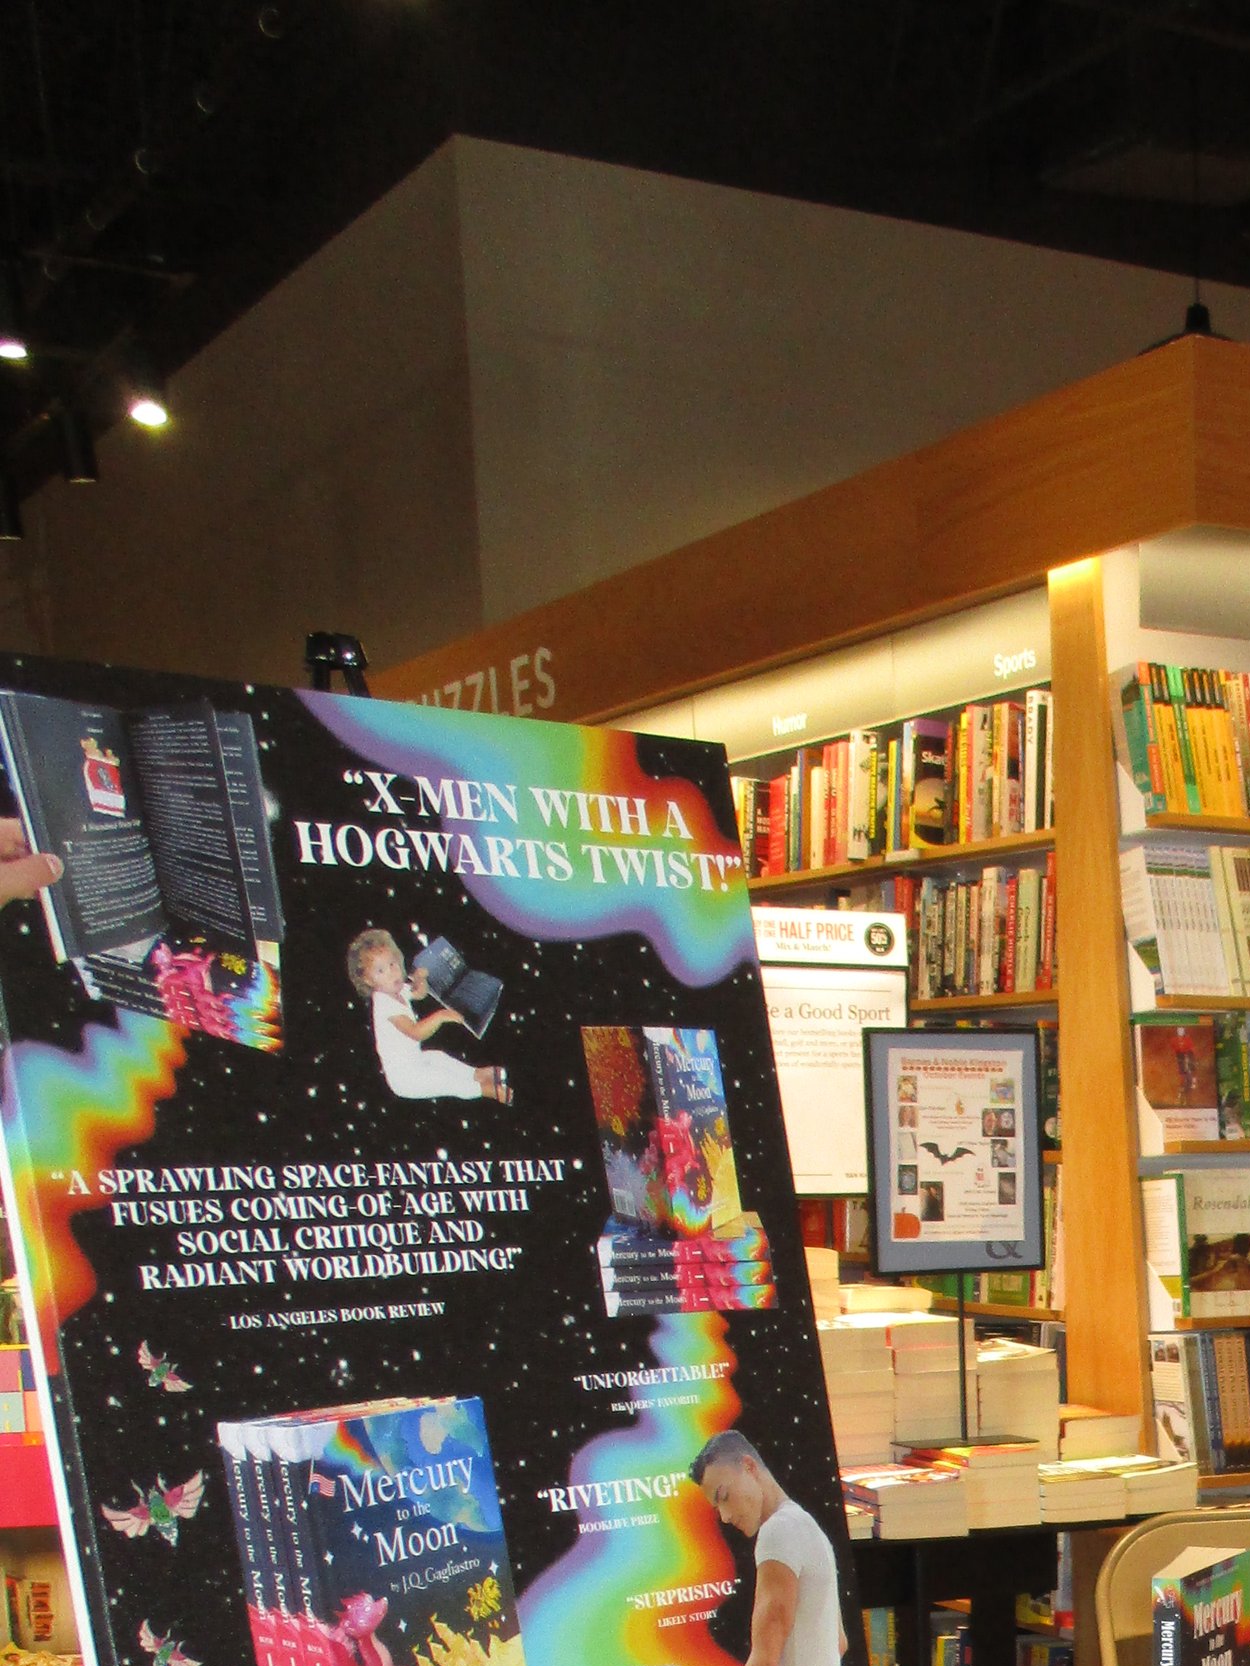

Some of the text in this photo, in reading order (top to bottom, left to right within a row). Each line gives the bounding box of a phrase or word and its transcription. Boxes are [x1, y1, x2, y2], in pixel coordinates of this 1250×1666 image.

[993, 648, 1037, 679] Sports
[404, 646, 556, 718] ZZLES
[772, 711, 808, 736] Humor
[528, 786, 651, 836] WITH
[662, 801, 694, 840] A
[294, 820, 574, 882] HOGWARTS
[779, 921, 855, 942] HALF PRICE
[784, 1007, 793, 1018] a
[798, 1002, 843, 1019] Good
[848, 1004, 891, 1024] Sport
[98, 1163, 277, 1196] SPRAWLING
[282, 1160, 493, 1191] SPACE-FANTASY
[499, 1158, 566, 1185] THAT
[111, 1188, 531, 1227] FUSUES COMING-OF-AGE WITH
[177, 1219, 485, 1257] SOCIAL CRITIQUE AND
[138, 1259, 278, 1291] RADIANT
[229, 1302, 446, 1330] LOS ANGELES BOOK REVIEW
[338, 1456, 474, 1513] Mercury
[396, 1501, 431, 1521] to the
[374, 1522, 460, 1568] Moon
[425, 1557, 481, 1586] Gagliastro
[657, 1608, 719, 1628] LIKELY STORY
[1192, 1589, 1242, 1640] Mercury
